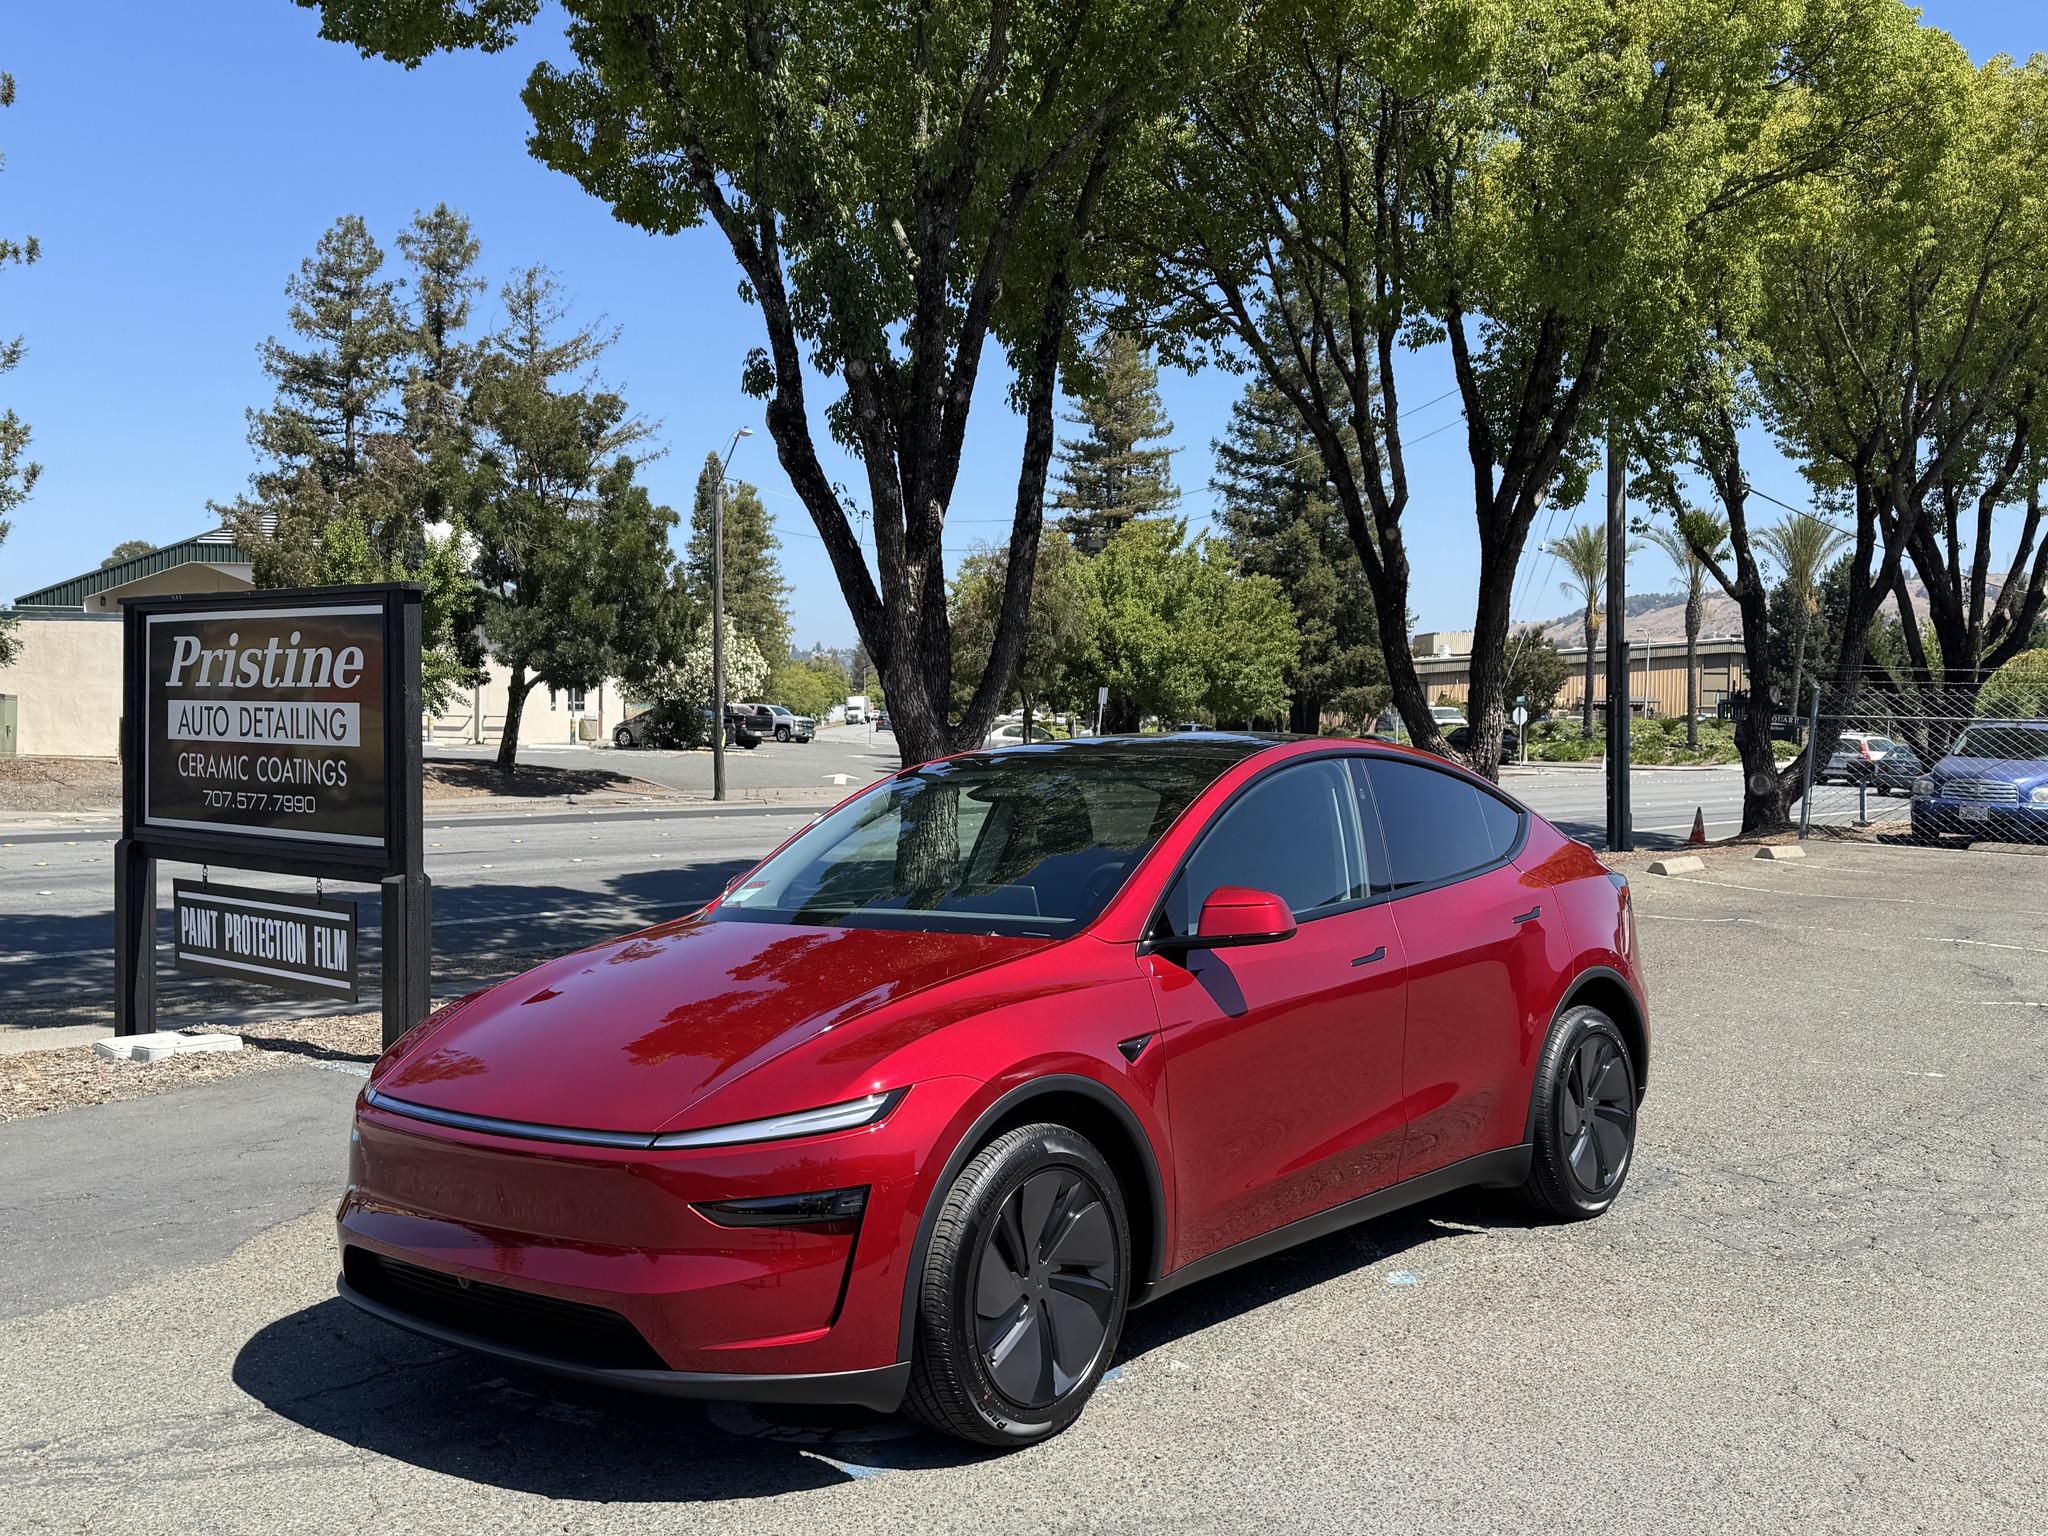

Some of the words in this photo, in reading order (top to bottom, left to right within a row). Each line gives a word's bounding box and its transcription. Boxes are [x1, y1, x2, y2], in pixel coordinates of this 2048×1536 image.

[165, 631, 364, 689] Pristine
[177, 705, 230, 737] AUTO
[239, 707, 347, 741] DETAILING
[178, 752, 249, 781] CERAMIC
[256, 756, 348, 787] COATINGS
[202, 789, 316, 814] 707.577.7990
[181, 905, 218, 949] PAINT
[224, 912, 307, 965] PROTECTION
[313, 925, 348, 972] FILM
